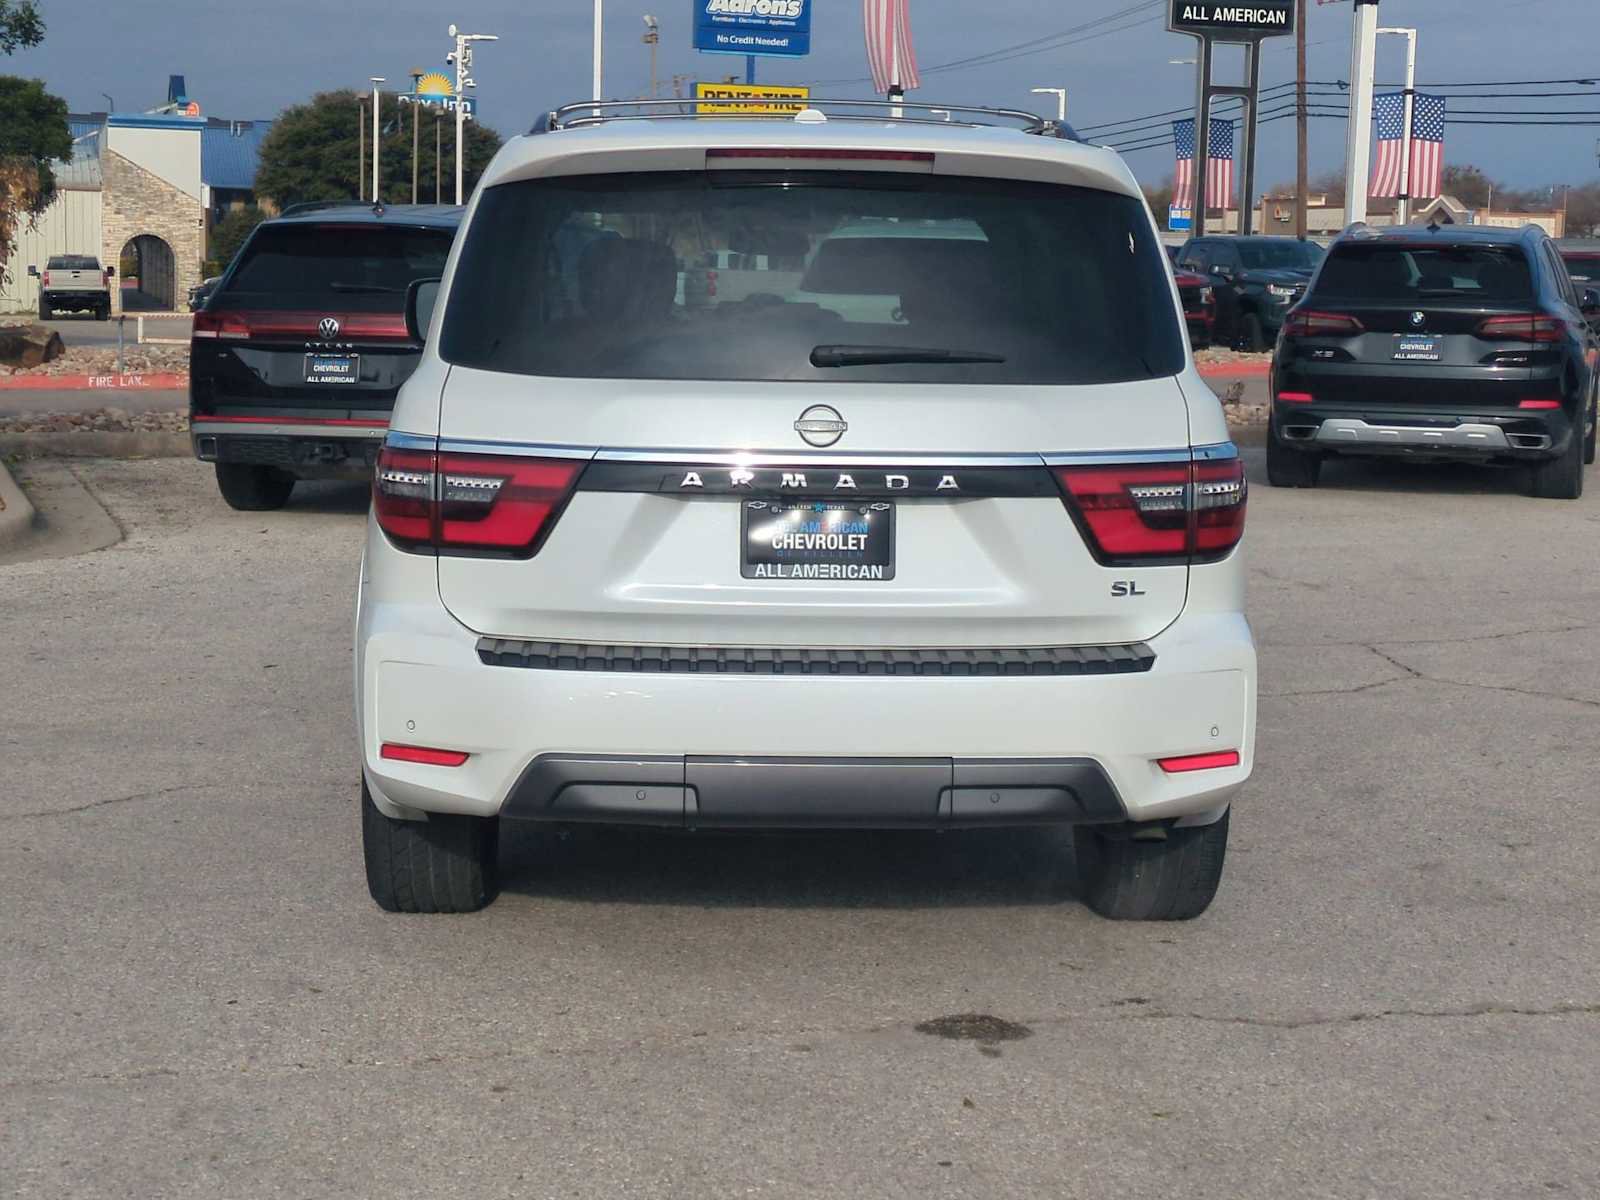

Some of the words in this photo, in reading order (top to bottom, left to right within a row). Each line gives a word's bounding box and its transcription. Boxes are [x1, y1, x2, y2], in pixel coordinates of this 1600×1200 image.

[1182, 6, 1209, 20] ALL
[1213, 7, 1286, 24] AMERICAN
[717, 34, 729, 43] No
[730, 35, 754, 45] Credit
[755, 37, 789, 47] Needed!
[88, 376, 114, 387] FIRE
[680, 470, 959, 490] ARMADA
[771, 534, 868, 550] CHEVROLET
[754, 563, 787, 578] ALL
[791, 564, 883, 579] AMERICAN
[1111, 580, 1145, 597] SL
